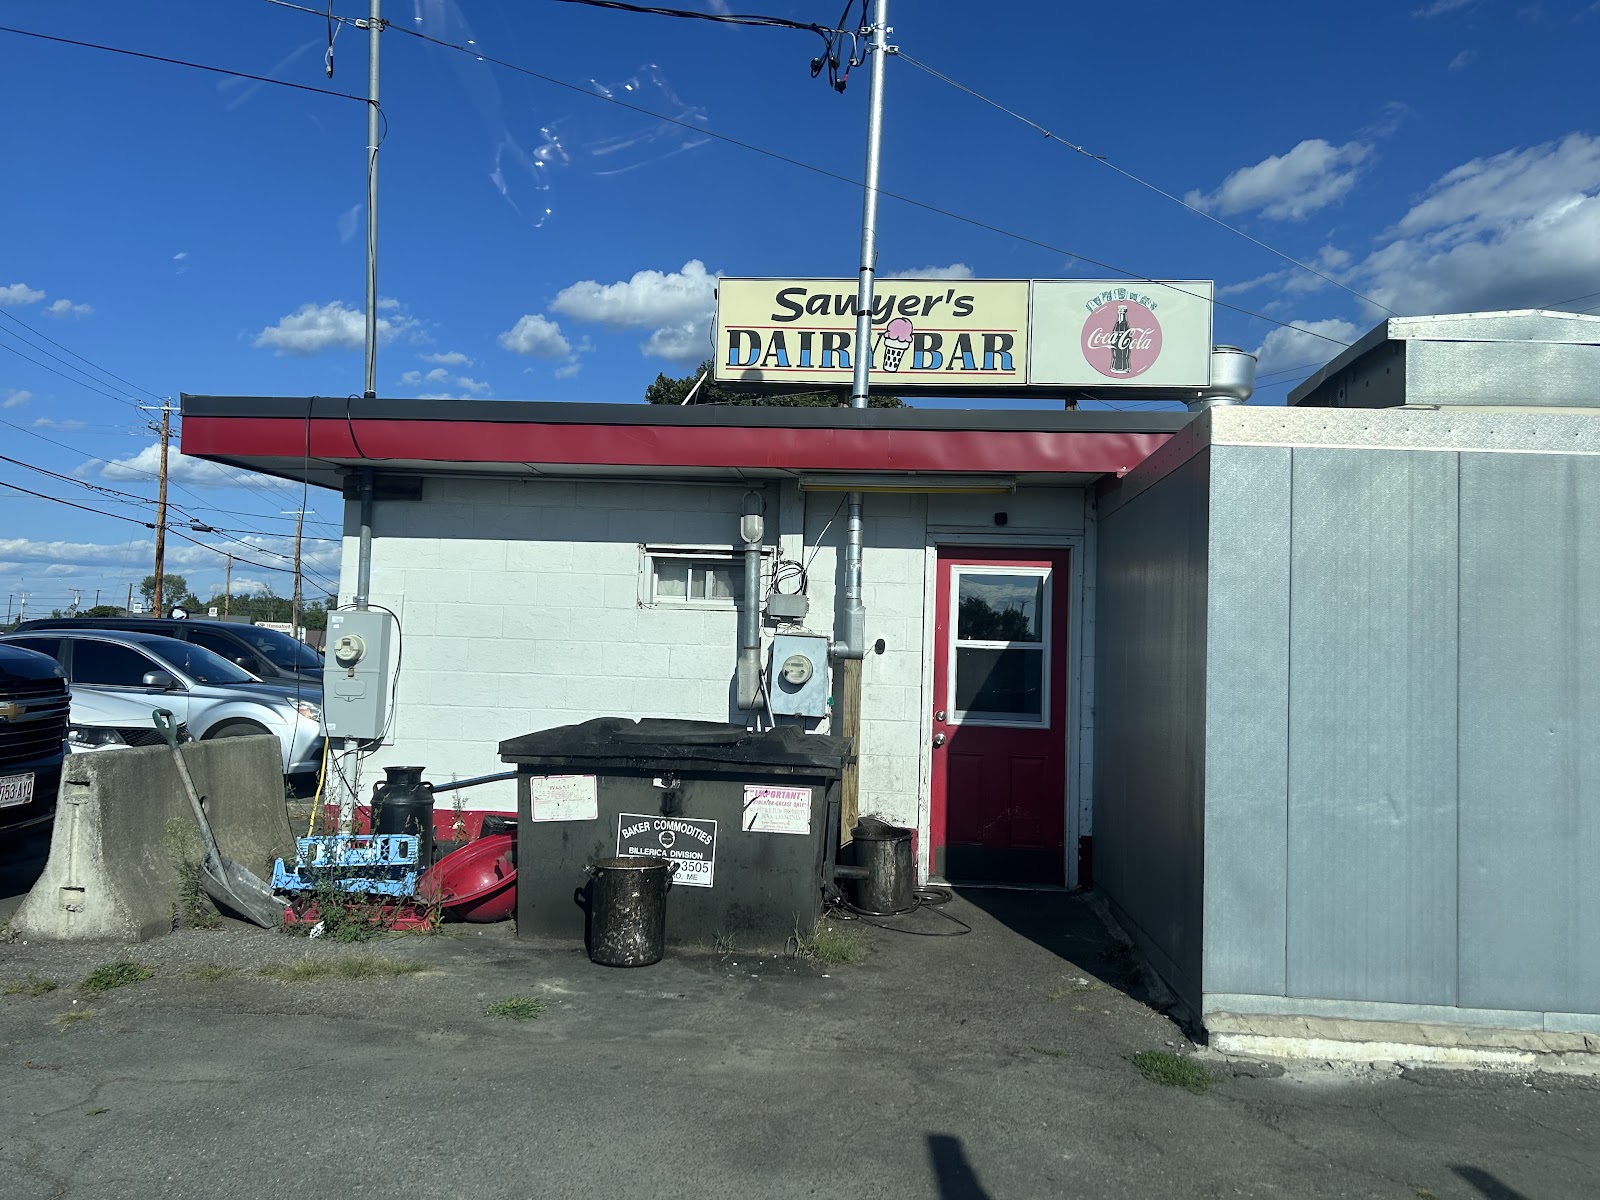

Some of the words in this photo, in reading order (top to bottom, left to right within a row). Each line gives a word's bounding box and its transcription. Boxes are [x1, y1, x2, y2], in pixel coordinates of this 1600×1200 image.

[771, 287, 975, 325] Sawyer's
[1087, 327, 1155, 350] Coca-Cola
[910, 332, 1016, 371] BAR
[622, 821, 651, 839] BAKER
[653, 820, 713, 845] COMMODITIES
[628, 846, 667, 857] BILLERICA
[670, 850, 703, 860] DIVISION
[686, 873, 698, 881] ME
